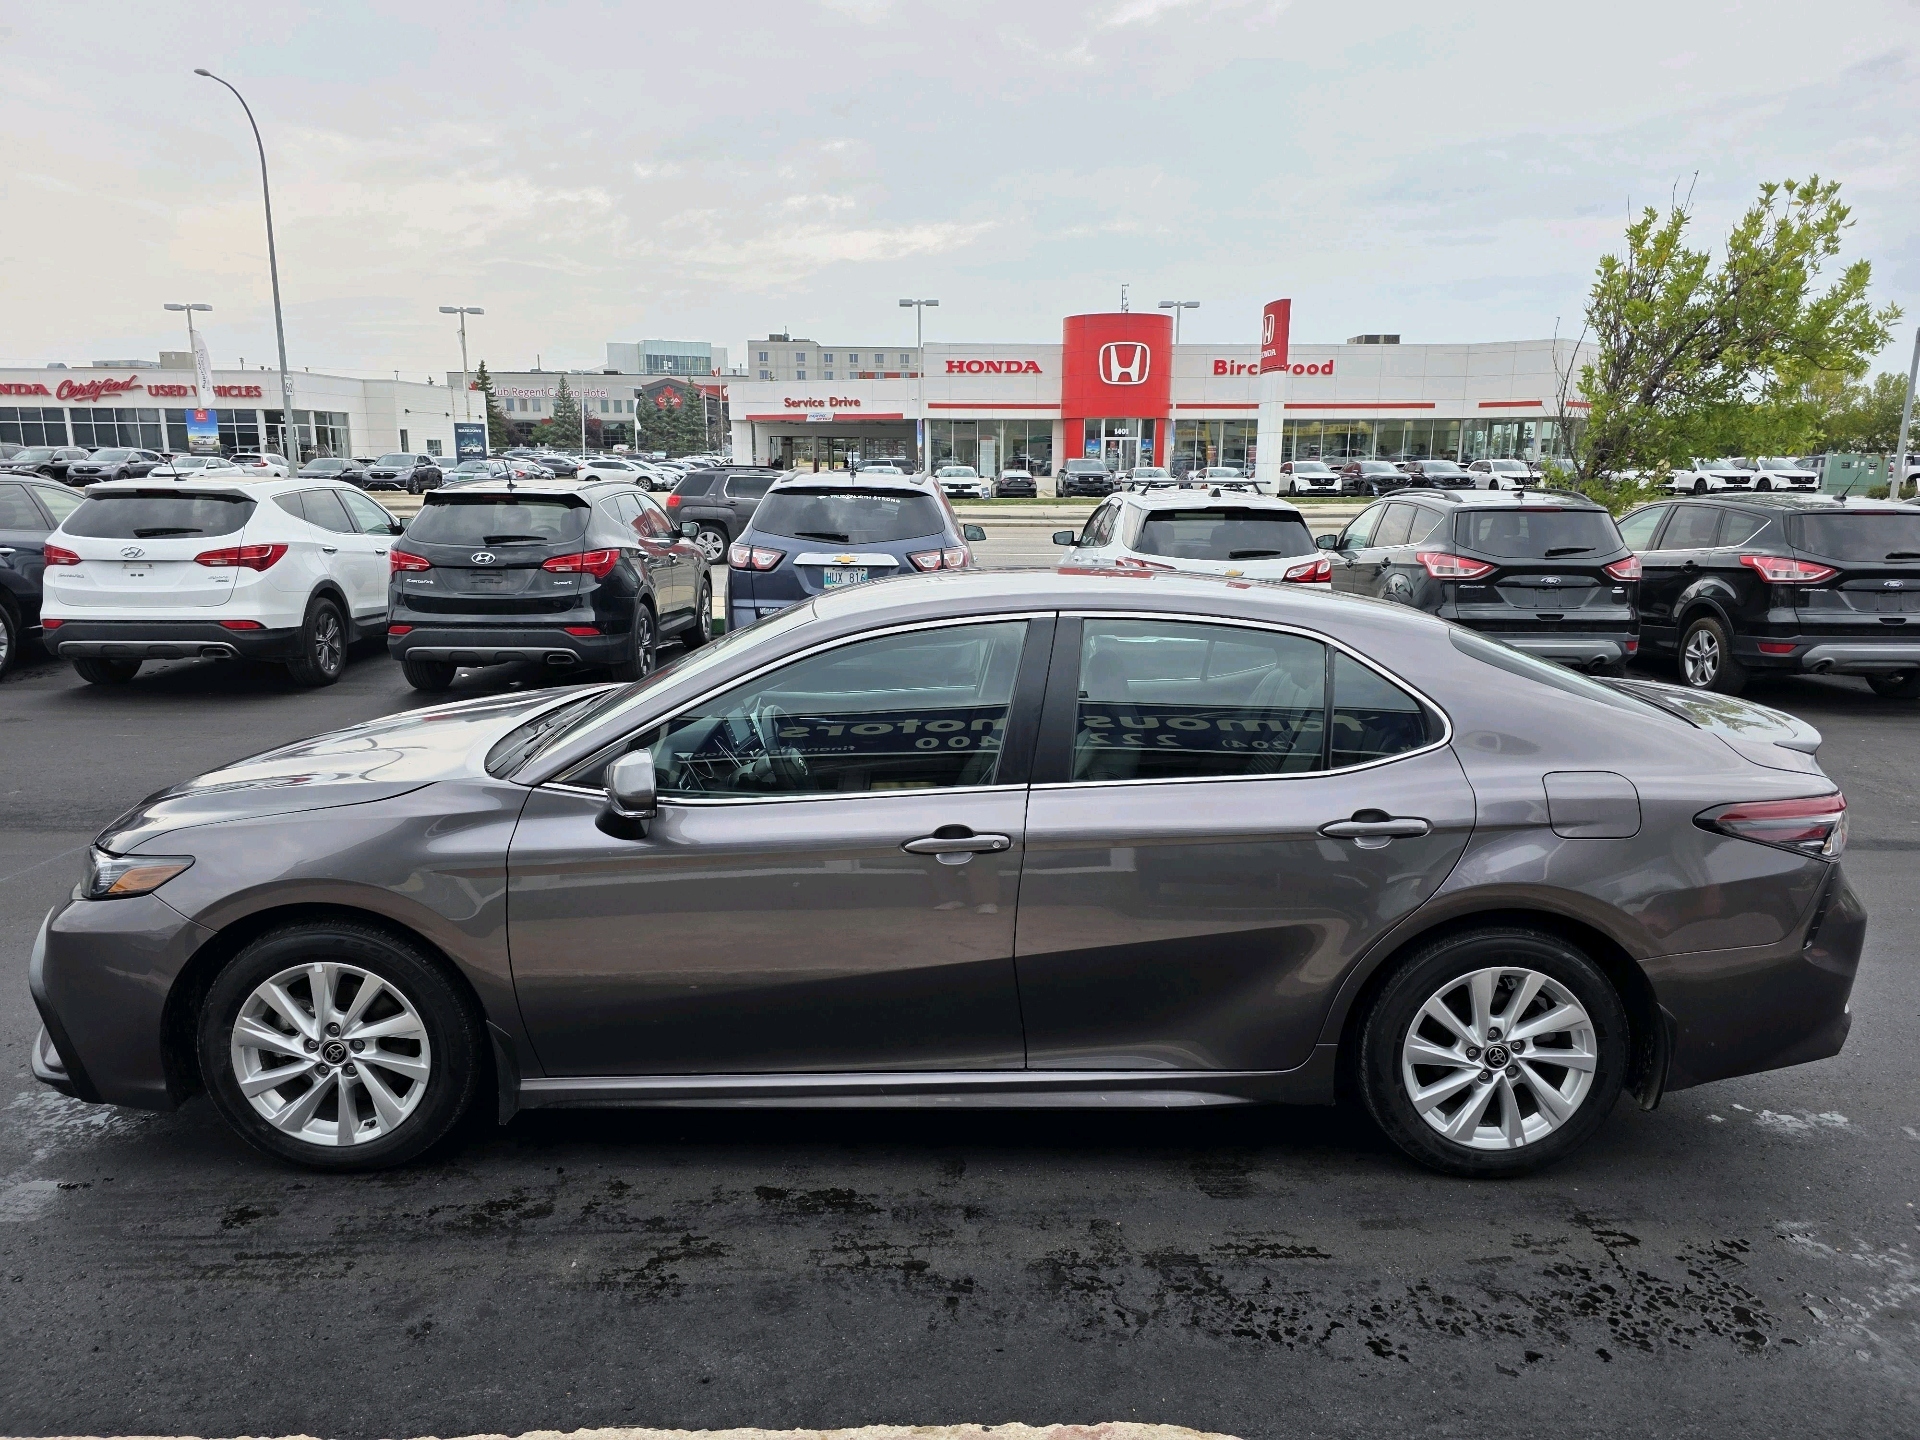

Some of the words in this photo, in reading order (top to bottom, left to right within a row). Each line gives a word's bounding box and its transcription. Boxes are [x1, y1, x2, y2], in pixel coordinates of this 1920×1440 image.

[946, 361, 1042, 373] HONDA
[1213, 359, 1334, 376] Bircood
[56, 374, 143, 402] Certified
[147, 385, 188, 397] USED
[512, 388, 545, 398] Regent
[584, 388, 609, 397] Hotel
[784, 396, 825, 407] Service
[829, 396, 861, 407] Drive
[826, 572, 843, 583] HUX
